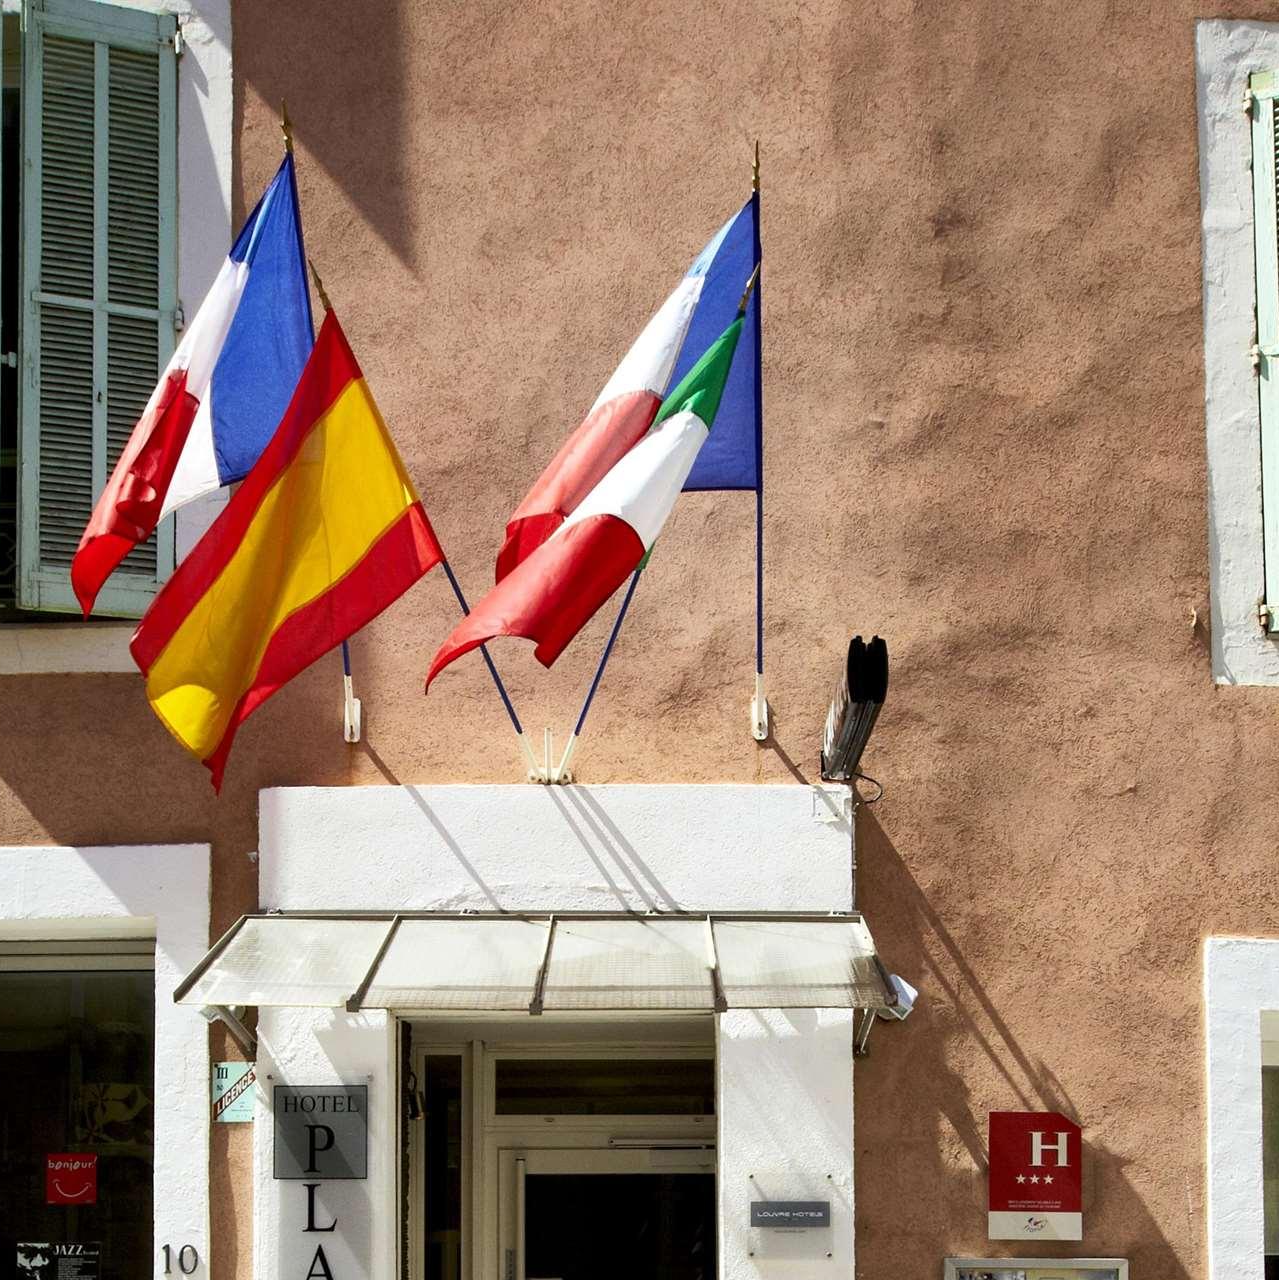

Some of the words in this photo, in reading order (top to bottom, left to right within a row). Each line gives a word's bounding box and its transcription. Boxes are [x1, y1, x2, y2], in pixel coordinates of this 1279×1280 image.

[217, 1071, 255, 1114] LICENCE
[284, 1095, 360, 1113] HOTEL
[1028, 1131, 1071, 1168] H
[53, 1245, 83, 1256] JAZZ
[162, 1243, 199, 1275] 10
